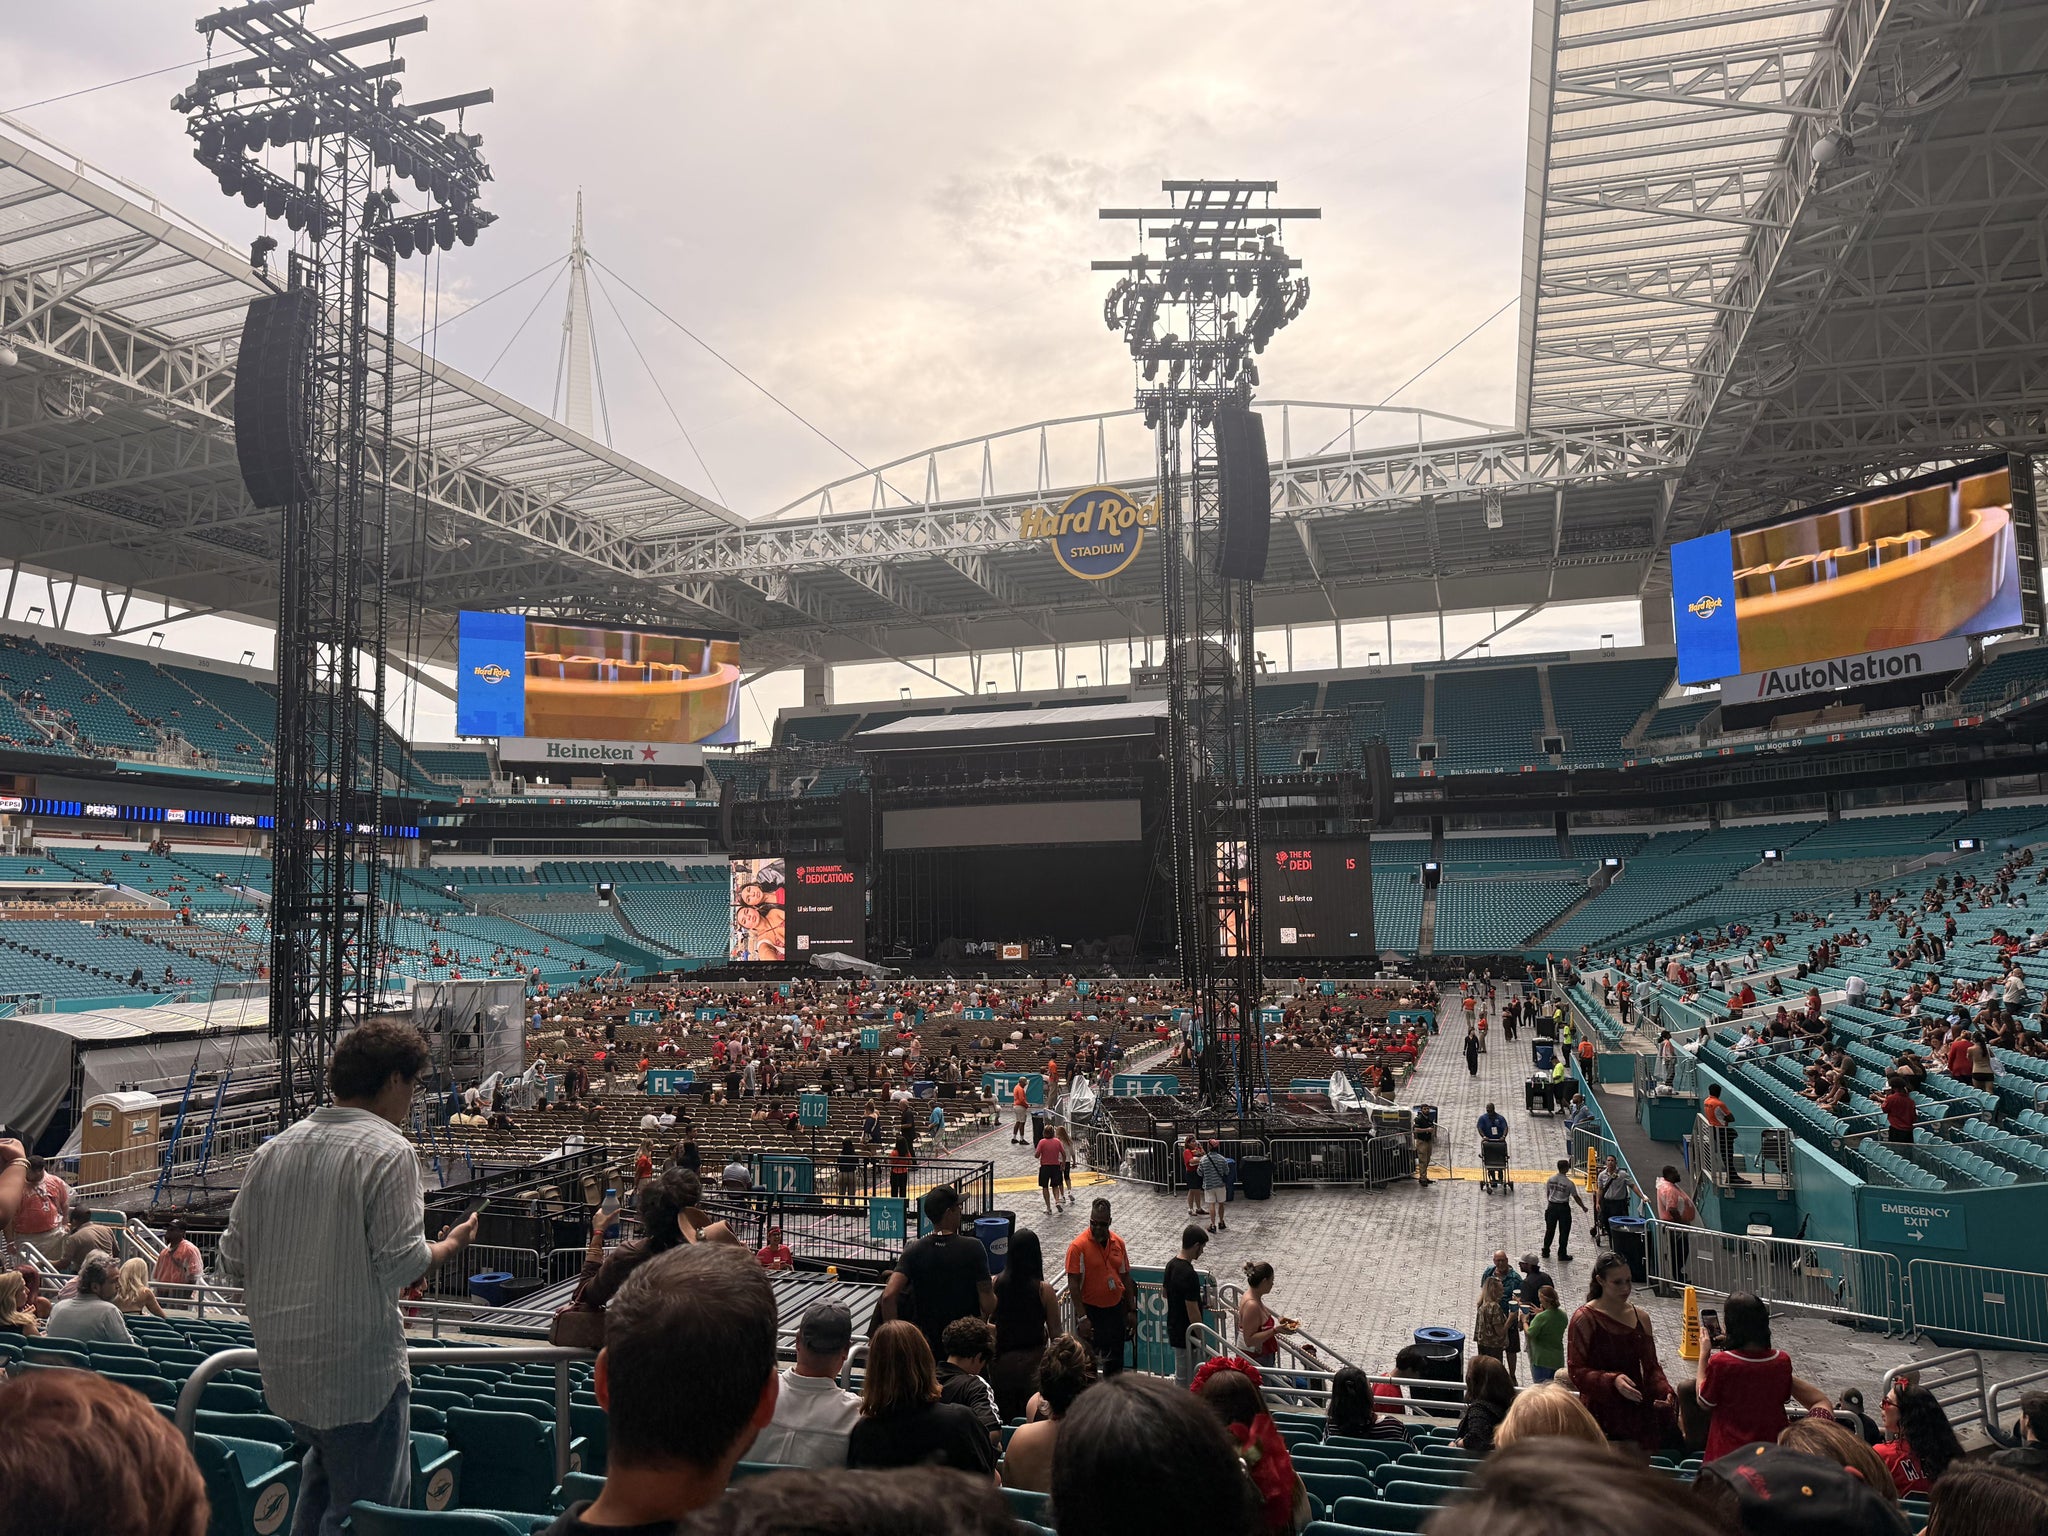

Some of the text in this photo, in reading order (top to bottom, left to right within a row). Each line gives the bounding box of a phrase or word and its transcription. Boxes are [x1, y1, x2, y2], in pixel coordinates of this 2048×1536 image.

[1020, 501, 1096, 539] Hard
[1070, 542, 1125, 558] STADIUM
[1766, 652, 1922, 696] AutoNation
[1860, 722, 1935, 738] LARRY CSONKA 39
[1767, 741, 1791, 750] MOORE
[1792, 739, 1802, 747] 89
[546, 742, 635, 760] Heineken
[86, 804, 117, 816] PEPSI
[230, 815, 255, 825] PEPSI
[1289, 850, 1302, 858] THE
[816, 865, 842, 873] ROMANTIC
[805, 872, 854, 884] DEDICATIONS
[702, 1012, 713, 1021] FL
[965, 1011, 985, 1020] FL 2
[1262, 1013, 1276, 1023] FL
[864, 1031, 871, 1043] FL
[654, 1077, 672, 1093] FL
[994, 1079, 1015, 1097] FL
[1126, 1080, 1143, 1096] FL
[802, 1103, 824, 1118] FL 12
[772, 1166, 797, 1192] 12
[1881, 1203, 1951, 1218] EMERGENCY
[877, 1220, 897, 1232] ADA-R
[1903, 1216, 1930, 1227] EXIT
